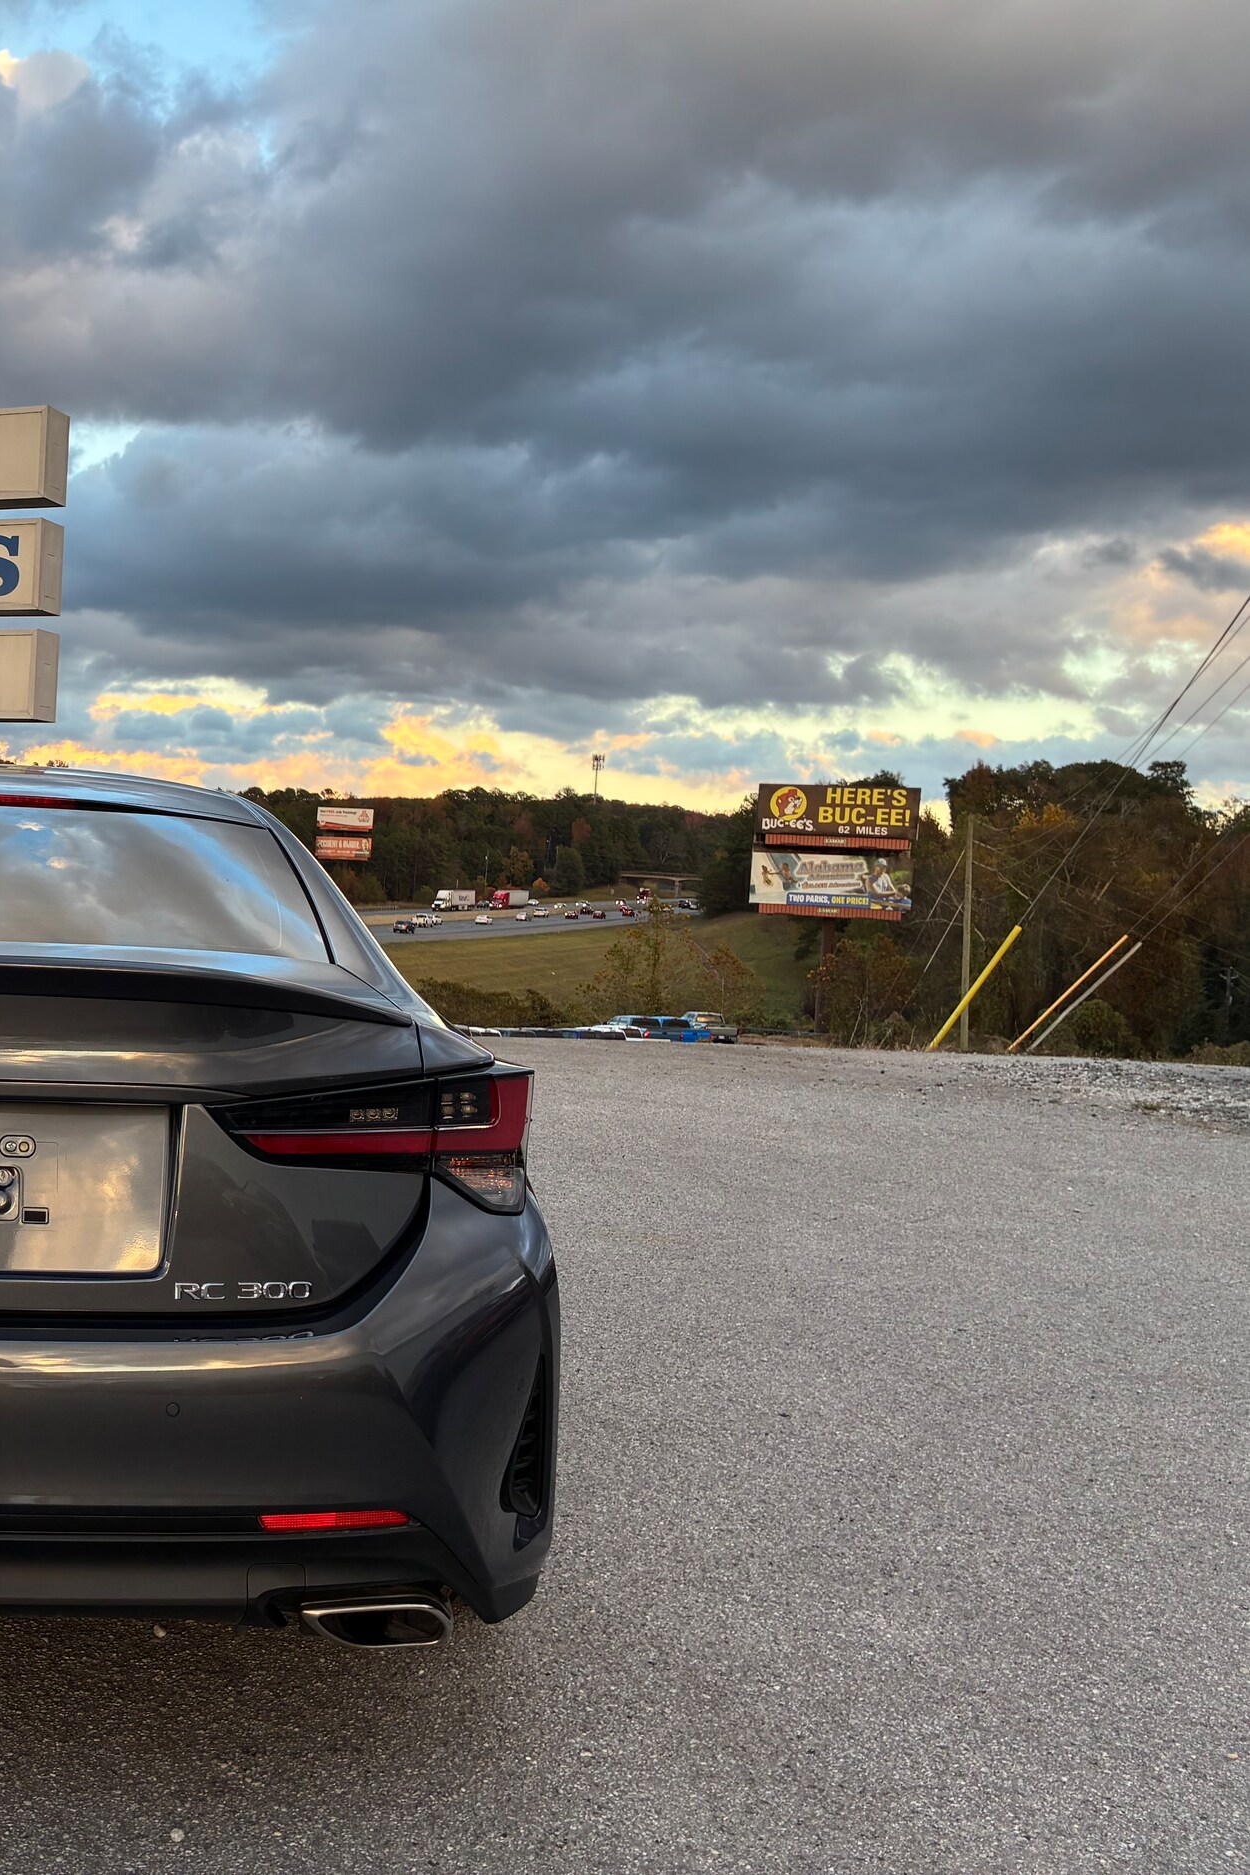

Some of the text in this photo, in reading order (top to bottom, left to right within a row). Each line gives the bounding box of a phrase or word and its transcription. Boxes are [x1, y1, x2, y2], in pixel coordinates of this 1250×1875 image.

[826, 787, 907, 806] HERE'S
[818, 806, 910, 826] BUC-EE!
[838, 826, 888, 835] 62 MILES
[789, 894, 869, 905] TWO PARKS, ONE PRICE!
[174, 1281, 313, 1300] RC 300
